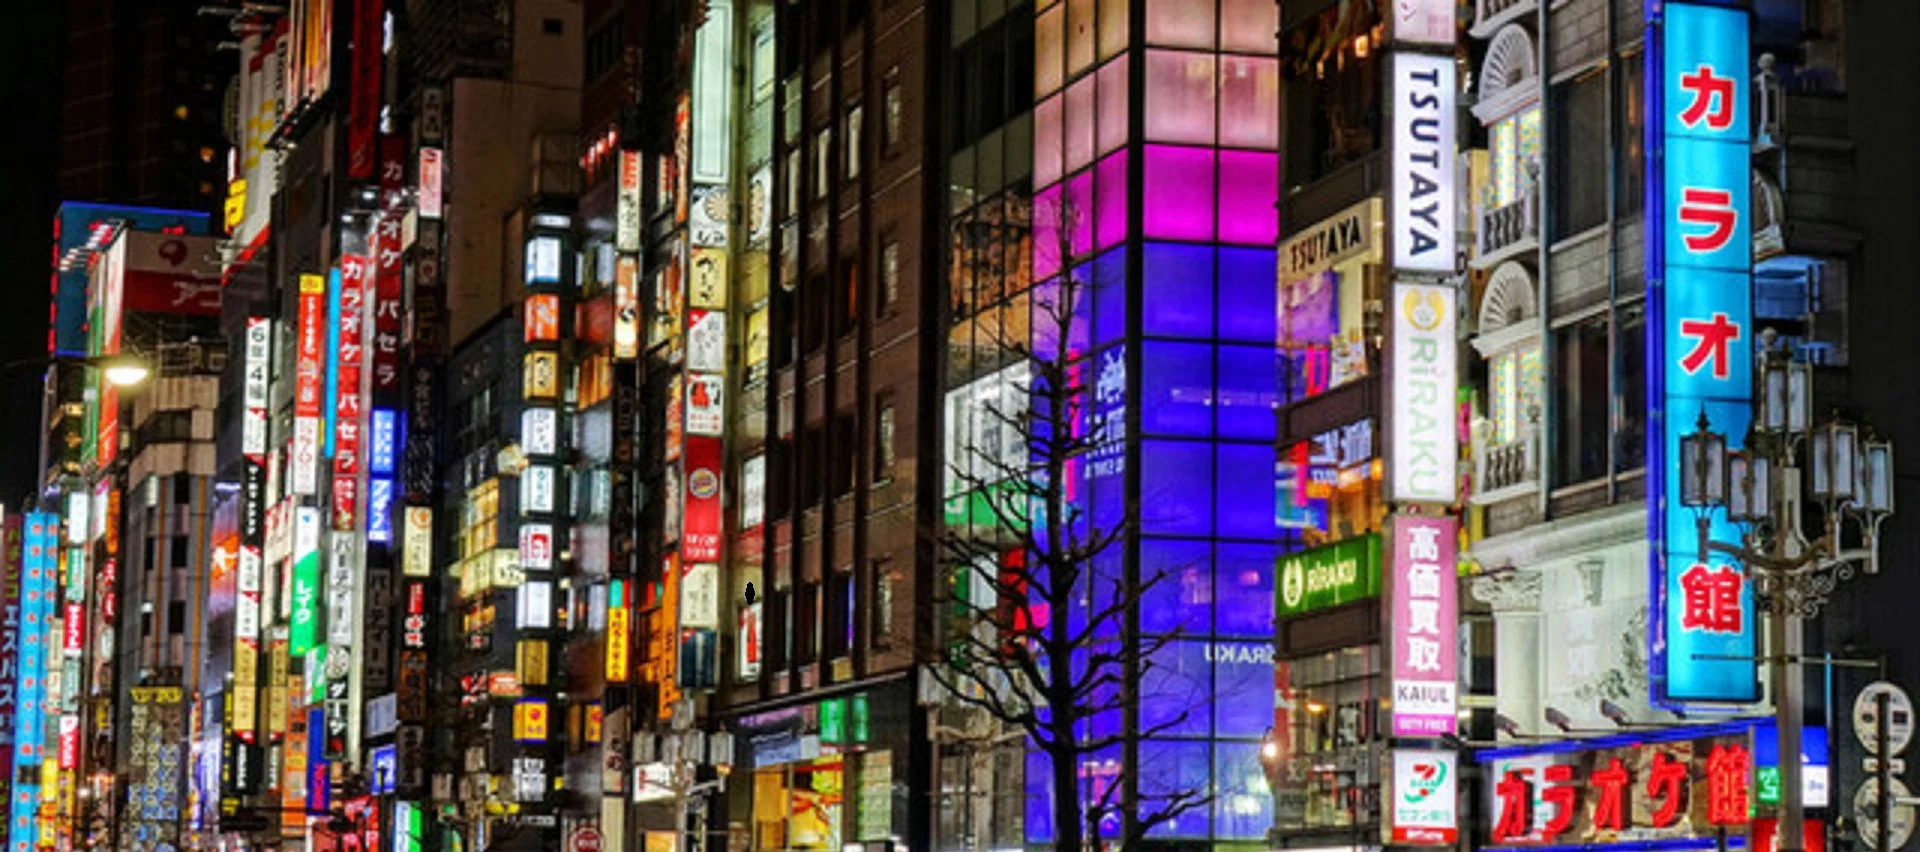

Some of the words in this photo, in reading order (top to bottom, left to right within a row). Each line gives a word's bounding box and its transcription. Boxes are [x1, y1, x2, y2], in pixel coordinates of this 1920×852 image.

[1409, 68, 1439, 257] TSUTAYA
[1290, 215, 1362, 273] TSUTAYA
[341, 259, 363, 361] カラオケ
[1680, 66, 1744, 634] カラオ館
[337, 392, 359, 470] パセラ
[1408, 335, 1447, 496] RiRAKU
[1406, 525, 1441, 673] 高価買取
[1493, 741, 1750, 844] カラオケ館
